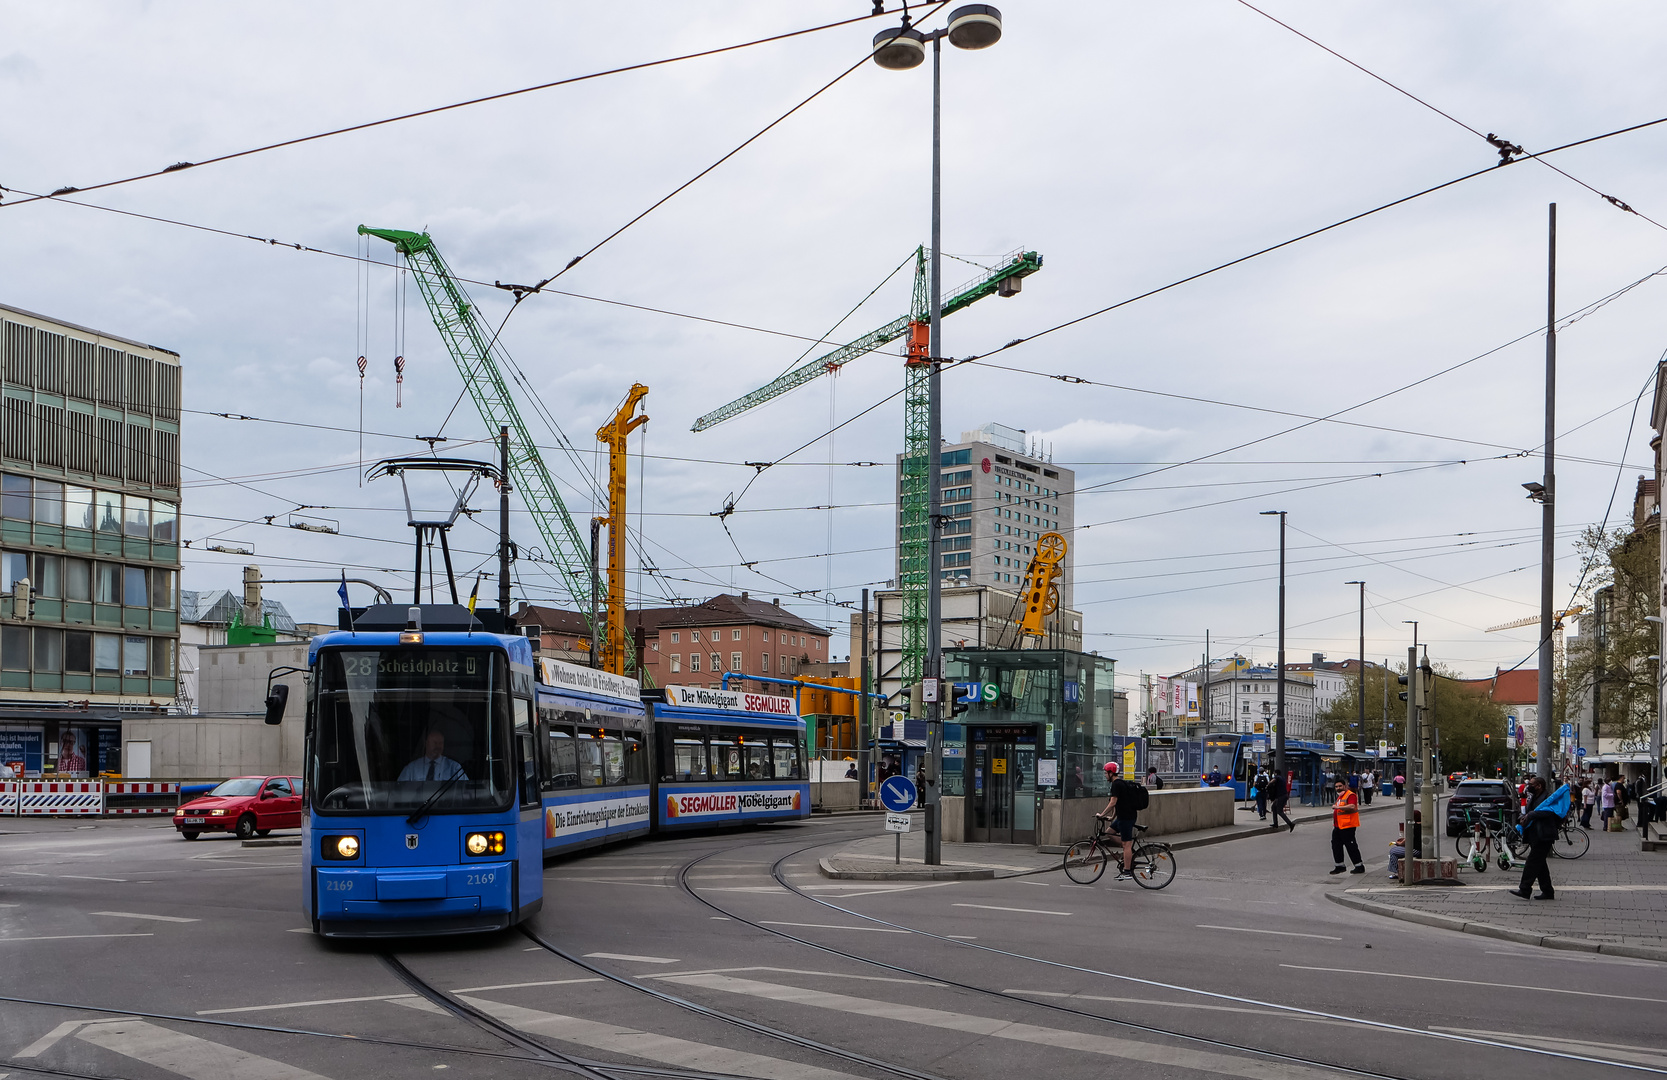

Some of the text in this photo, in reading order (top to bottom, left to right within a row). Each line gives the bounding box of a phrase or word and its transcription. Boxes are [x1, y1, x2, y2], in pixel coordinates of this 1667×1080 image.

[346, 656, 372, 676] 28
[378, 659, 459, 676] Scheidplatz
[681, 689, 791, 714] Der Möbelgigant SEGMÜLLER
[966, 684, 997, 700] U S
[680, 794, 792, 813] SEGMÜLLER Möbelgigant
[555, 803, 649, 829] Die Einrichtungshäuser der Extraklasse
[326, 880, 353, 891] 2169
[467, 873, 495, 885] 2169
